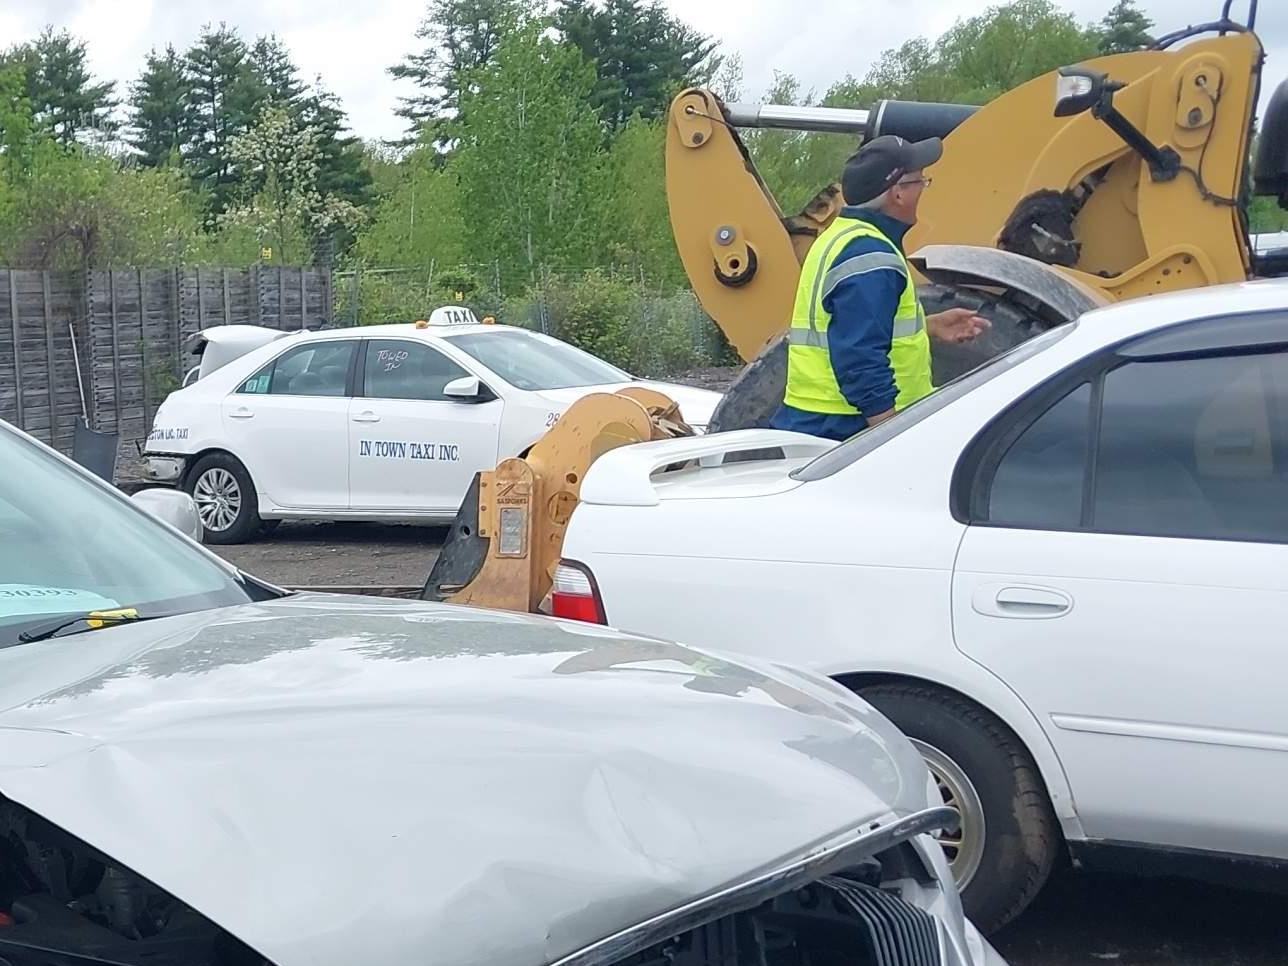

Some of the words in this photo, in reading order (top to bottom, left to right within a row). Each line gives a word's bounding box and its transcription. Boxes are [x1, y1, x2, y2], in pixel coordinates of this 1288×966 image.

[444, 310, 474, 323] TAXI
[376, 350, 409, 361] TOWED
[360, 440, 372, 456] IN
[375, 441, 406, 458] TOWN
[410, 443, 435, 460] TAXI
[439, 445, 460, 461] INC.
